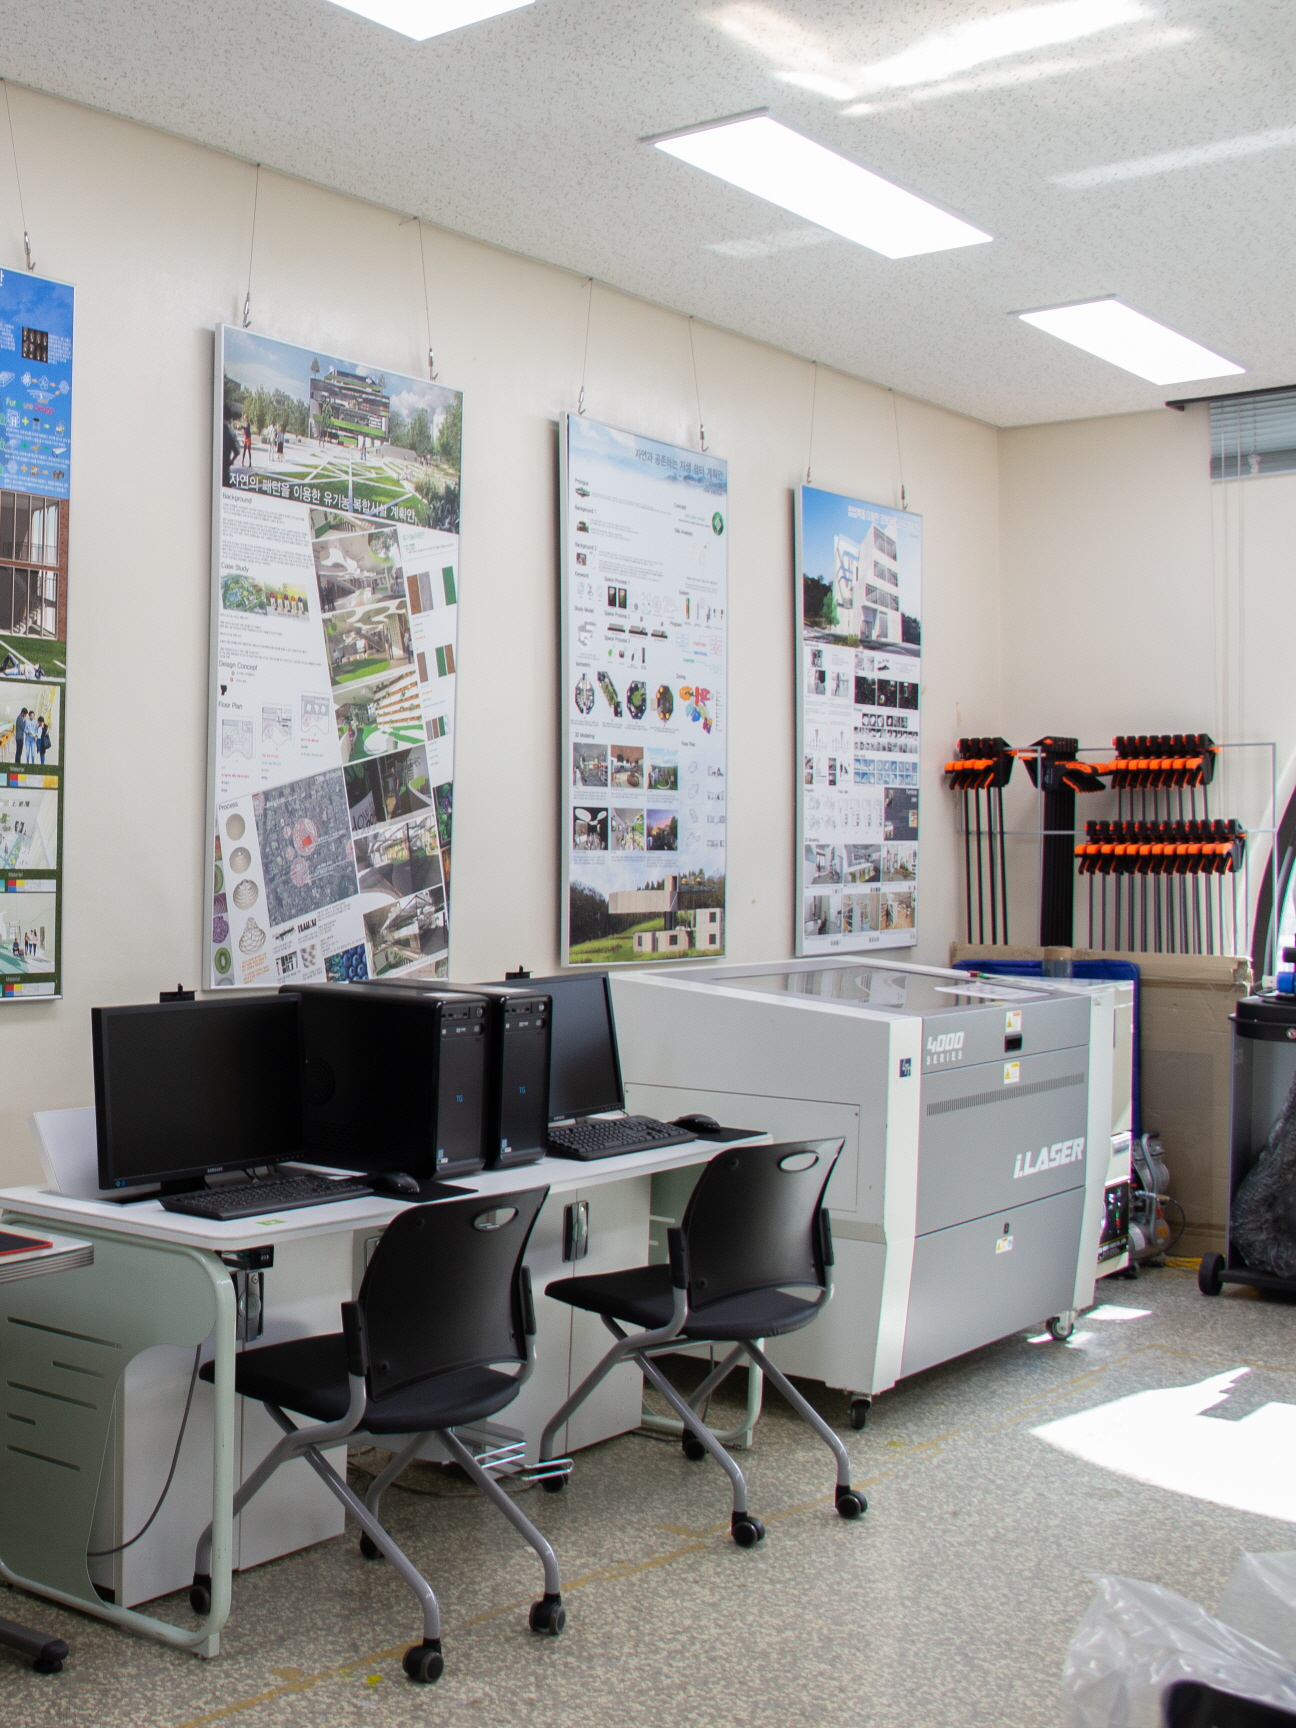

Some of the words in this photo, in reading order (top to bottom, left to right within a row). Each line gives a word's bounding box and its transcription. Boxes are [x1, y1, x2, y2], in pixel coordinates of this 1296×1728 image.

[6, 397, 33, 410] Furure
[223, 492, 253, 504] Background
[229, 472, 259, 492] 자연의
[294, 486, 321, 504] 이용한
[324, 491, 349, 510] 유기농
[353, 498, 387, 516] 복합시설
[391, 505, 416, 523] 계획안
[221, 562, 233, 570] Case
[235, 563, 249, 572] Study
[237, 662, 258, 671] Concept
[218, 701, 231, 709] Floor
[218, 801, 238, 811] Process
[926, 1031, 965, 1053] 4000
[926, 1051, 963, 1065] SERIES
[519, 1086, 526, 1094] TG
